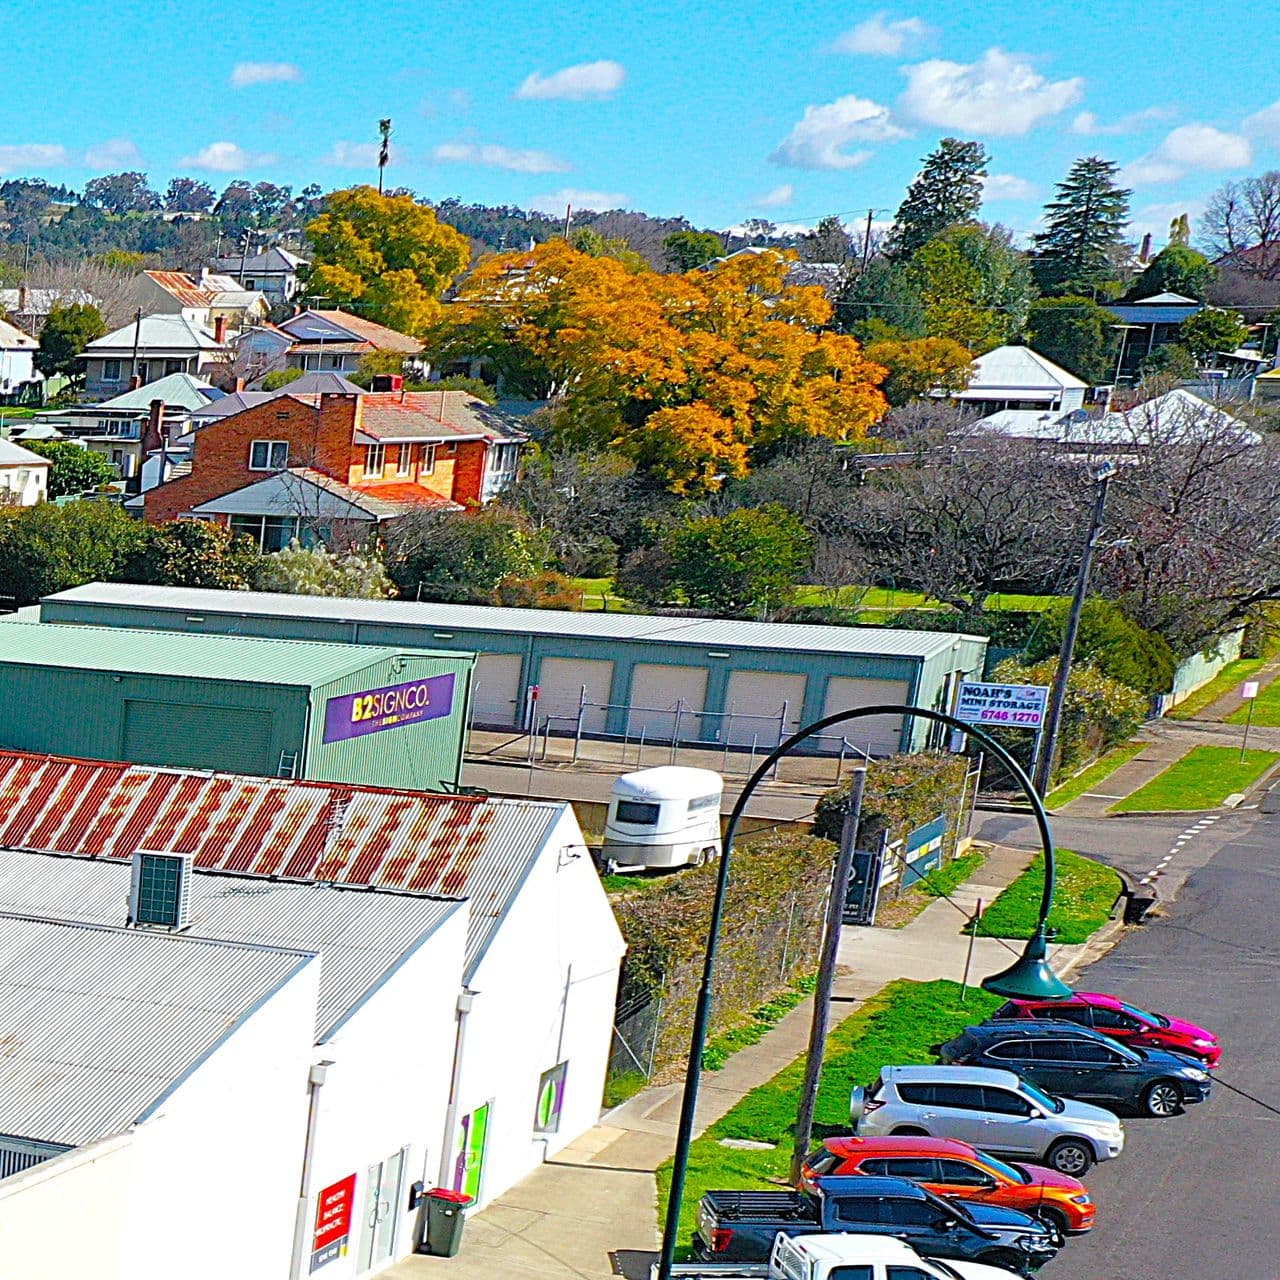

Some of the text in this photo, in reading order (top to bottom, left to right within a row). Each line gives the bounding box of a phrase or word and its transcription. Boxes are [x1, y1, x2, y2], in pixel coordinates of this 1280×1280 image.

[962, 687, 1012, 699] NOAH'S
[961, 697, 1041, 710] MINI STORAGE
[981, 710, 1008, 720] 6746
[1011, 712, 1040, 723] 1270
